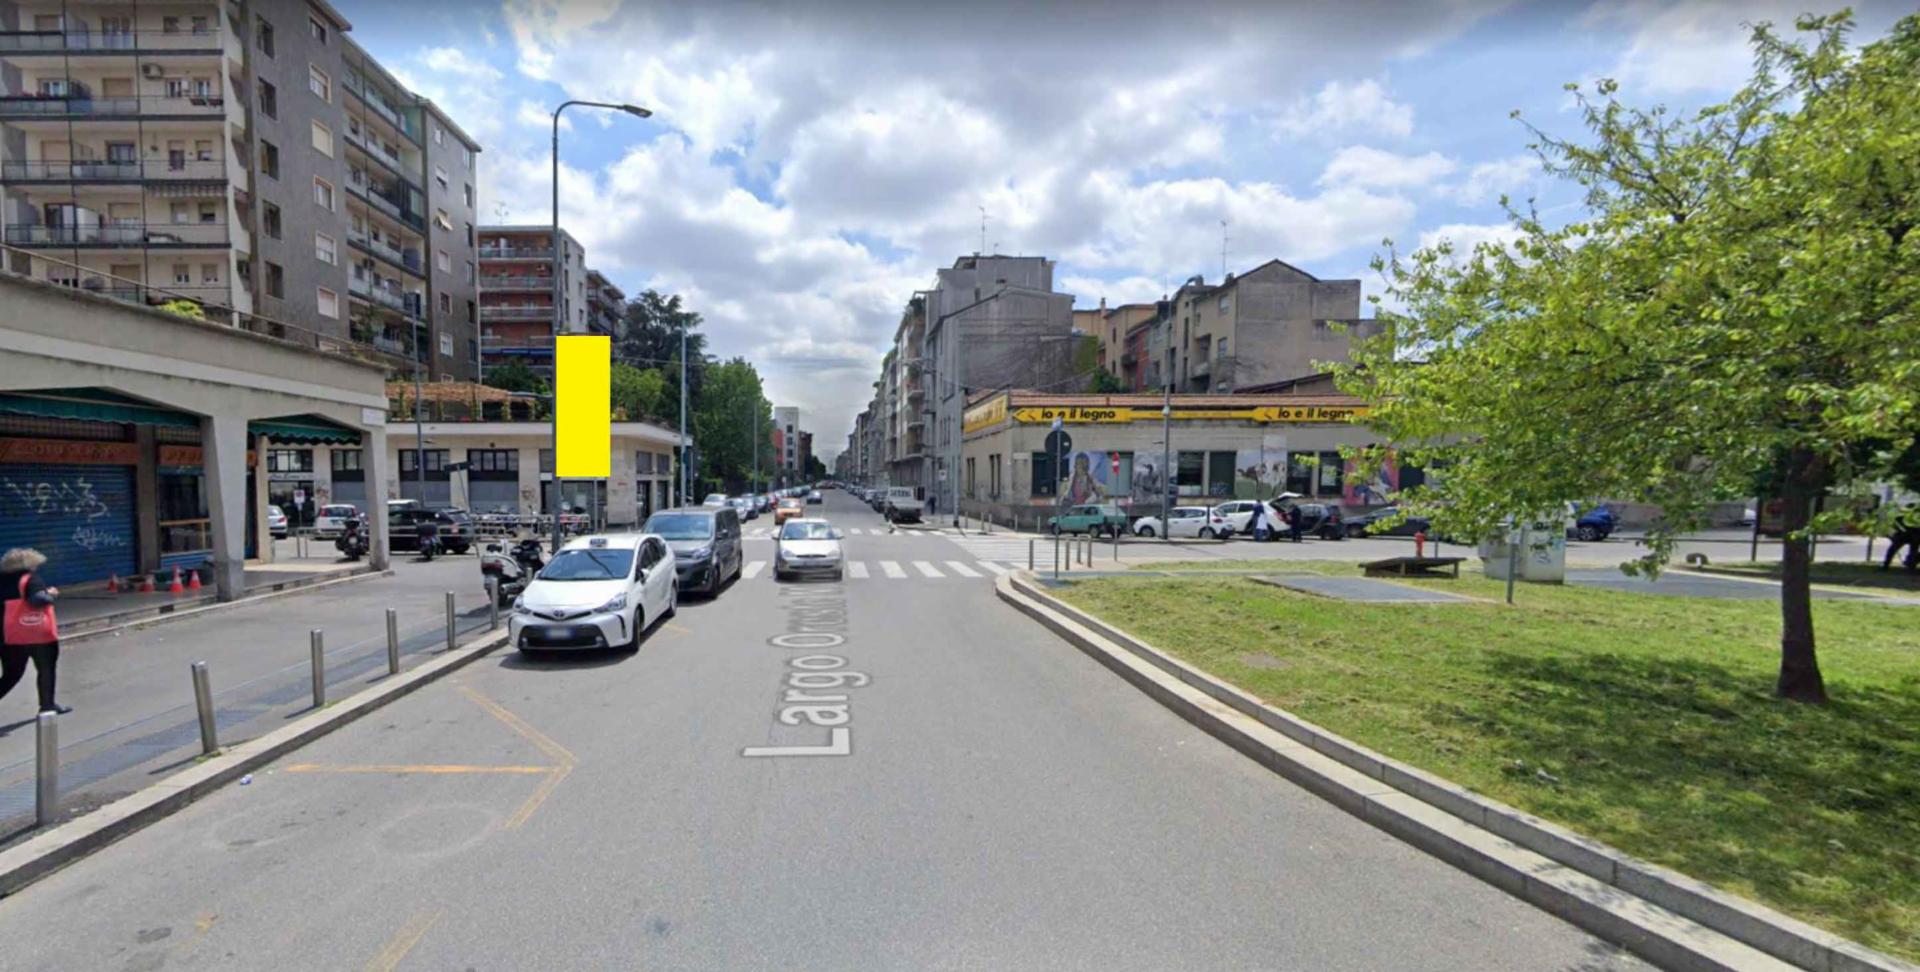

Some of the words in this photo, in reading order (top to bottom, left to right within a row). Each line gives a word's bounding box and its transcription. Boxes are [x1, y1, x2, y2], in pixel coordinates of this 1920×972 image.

[1069, 407, 1077, 419] il
[1080, 407, 1116, 421] legno
[1295, 410, 1303, 419] e
[1307, 407, 1315, 419] il
